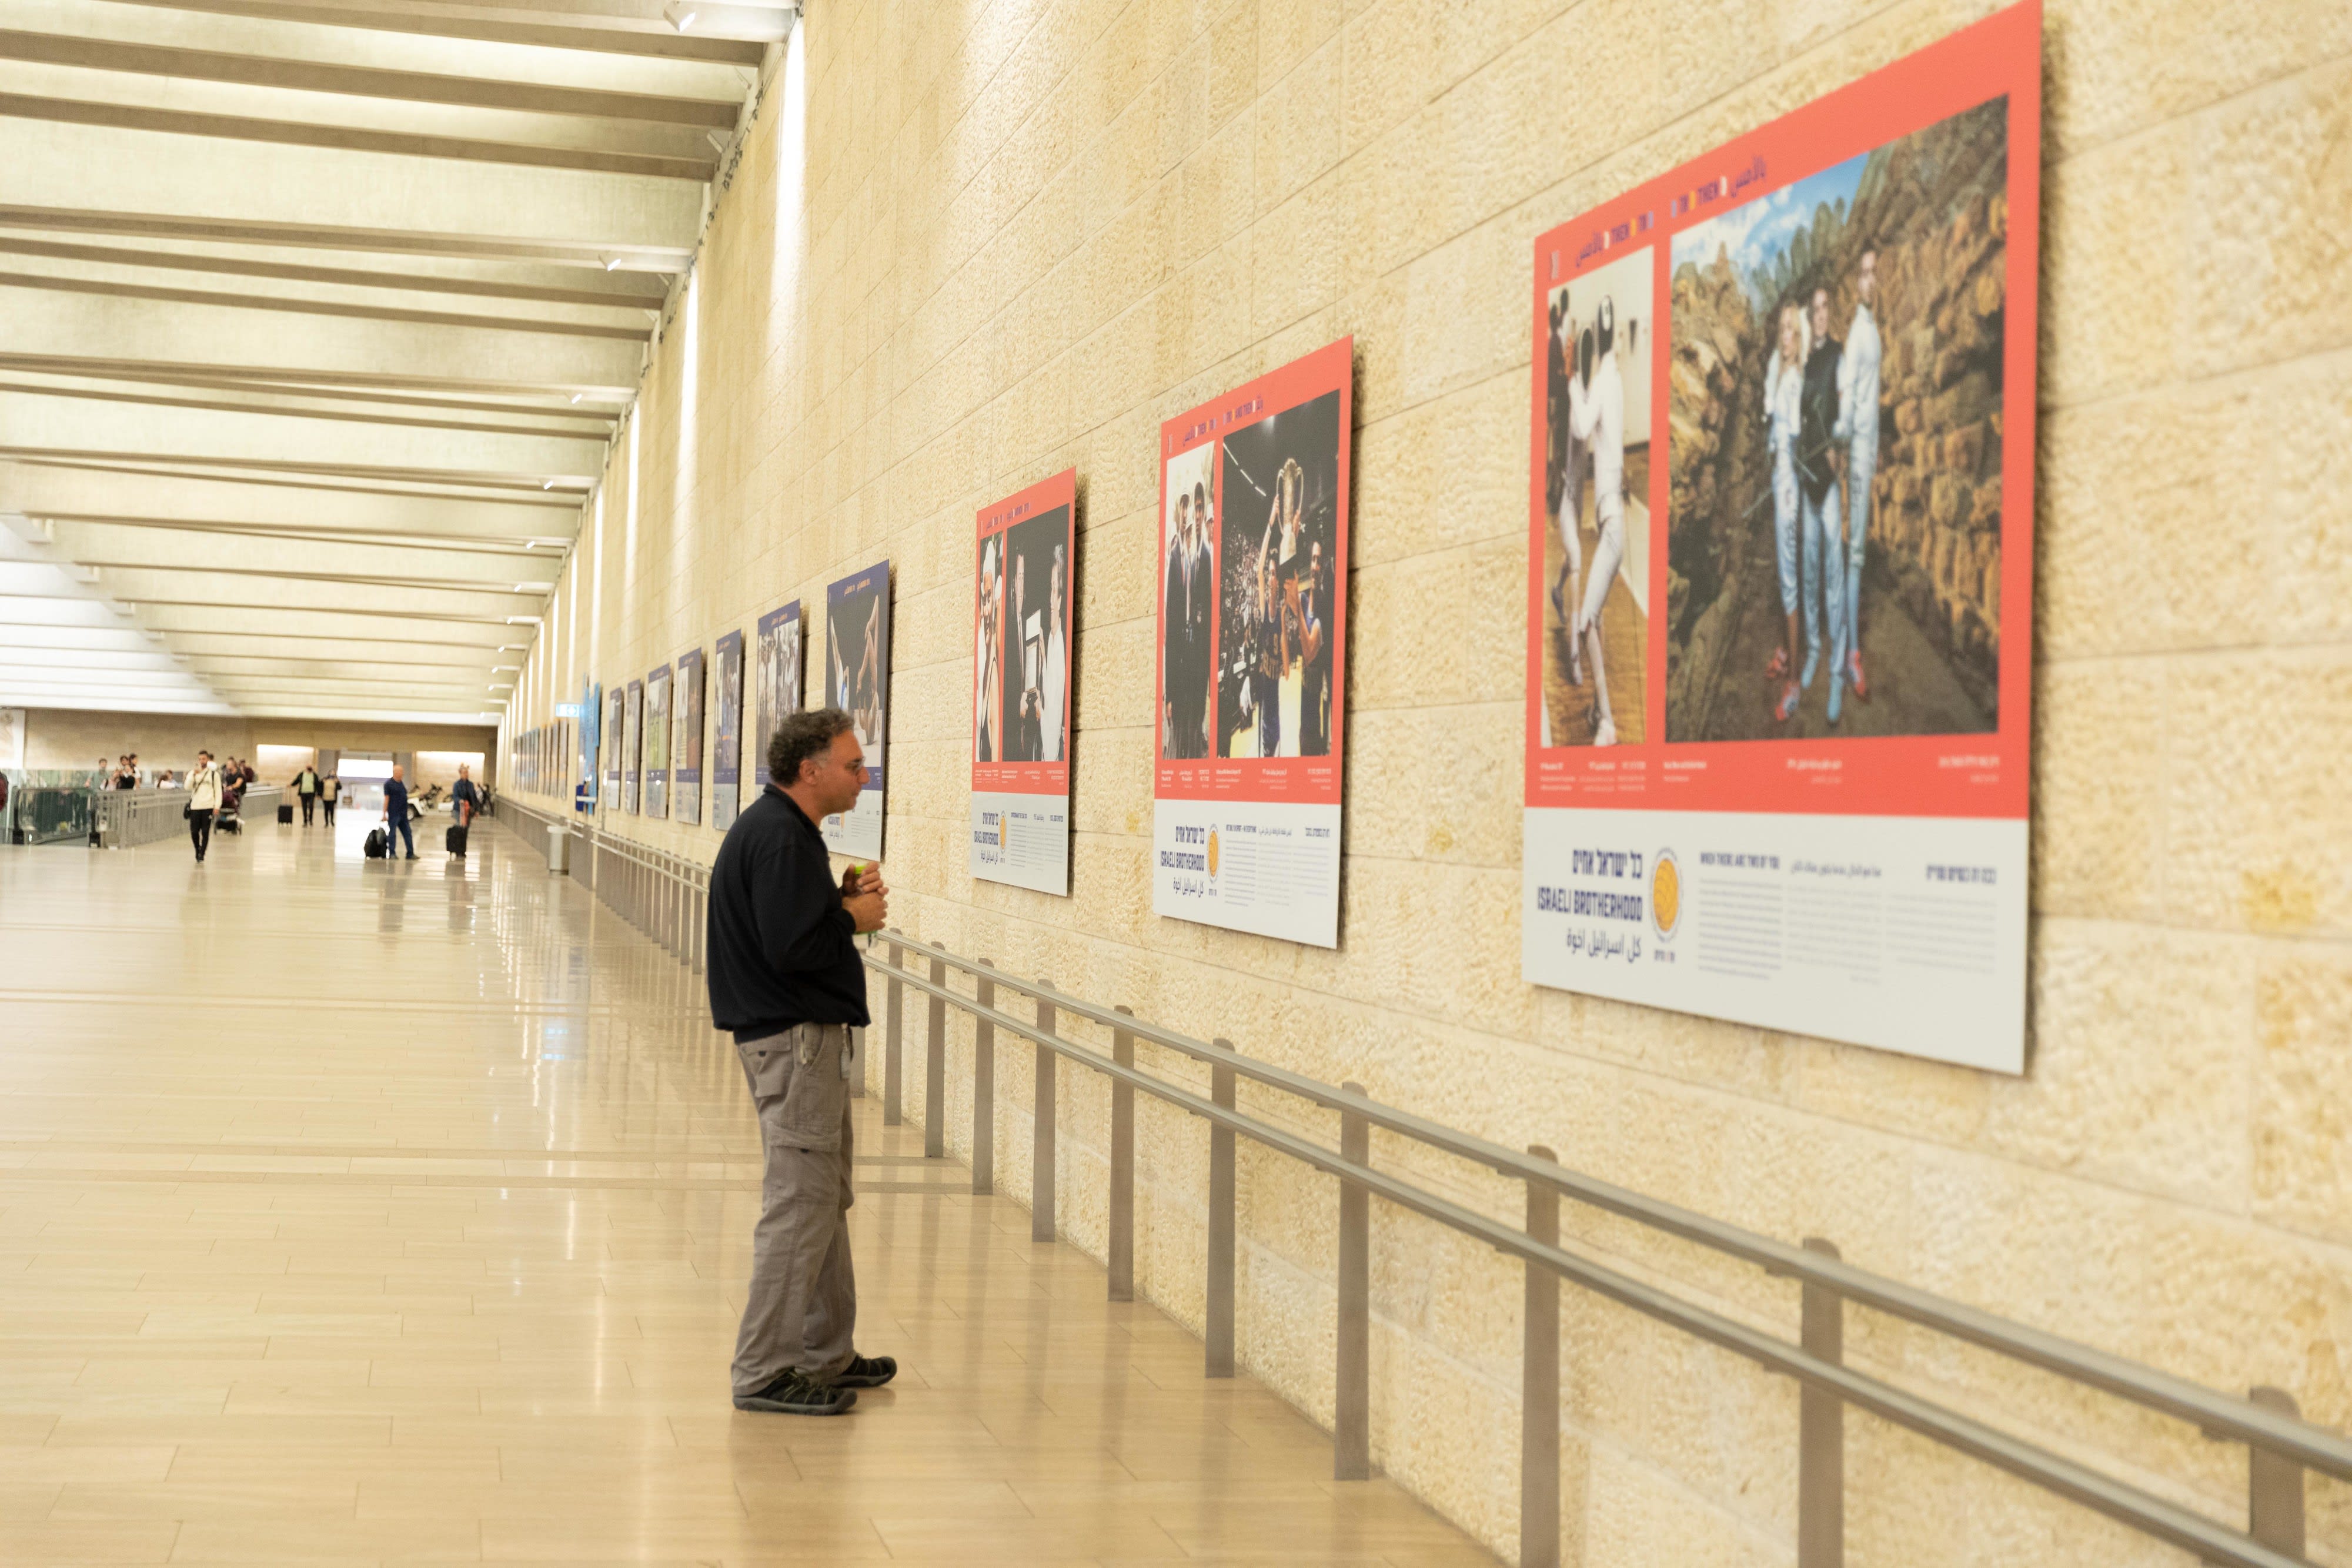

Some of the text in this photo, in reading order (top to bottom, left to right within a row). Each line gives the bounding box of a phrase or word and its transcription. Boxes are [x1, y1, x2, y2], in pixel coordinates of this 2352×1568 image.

[1160, 850, 1204, 871] ISRAELI BROTHERHOOD
[1538, 886, 1642, 922] ISRAELI BROTHERHOOD
